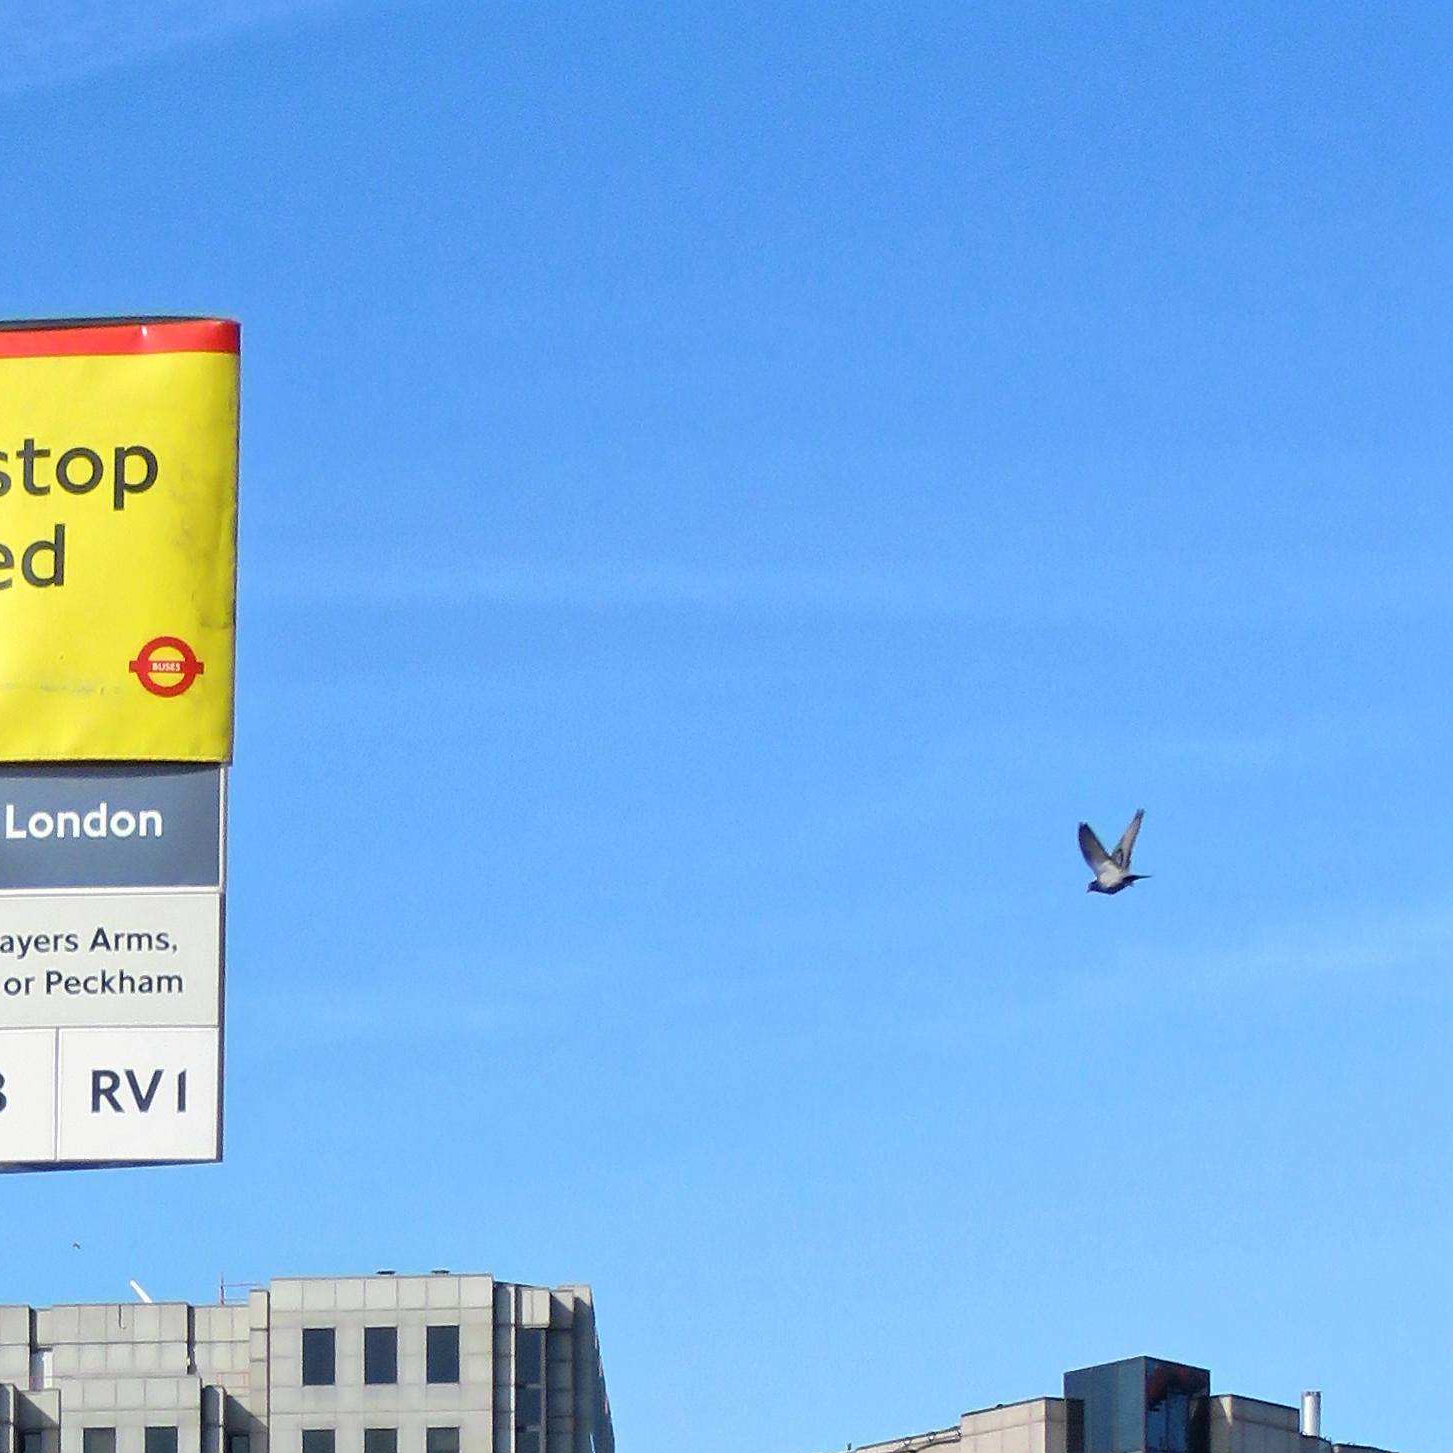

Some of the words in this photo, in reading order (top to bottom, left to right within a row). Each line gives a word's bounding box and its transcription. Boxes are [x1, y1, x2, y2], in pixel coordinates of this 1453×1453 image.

[151, 662, 181, 672] BUSES
[4, 802, 163, 841] London
[88, 926, 179, 955] Arms,
[3, 974, 36, 997] or
[44, 968, 184, 997] Peckham
